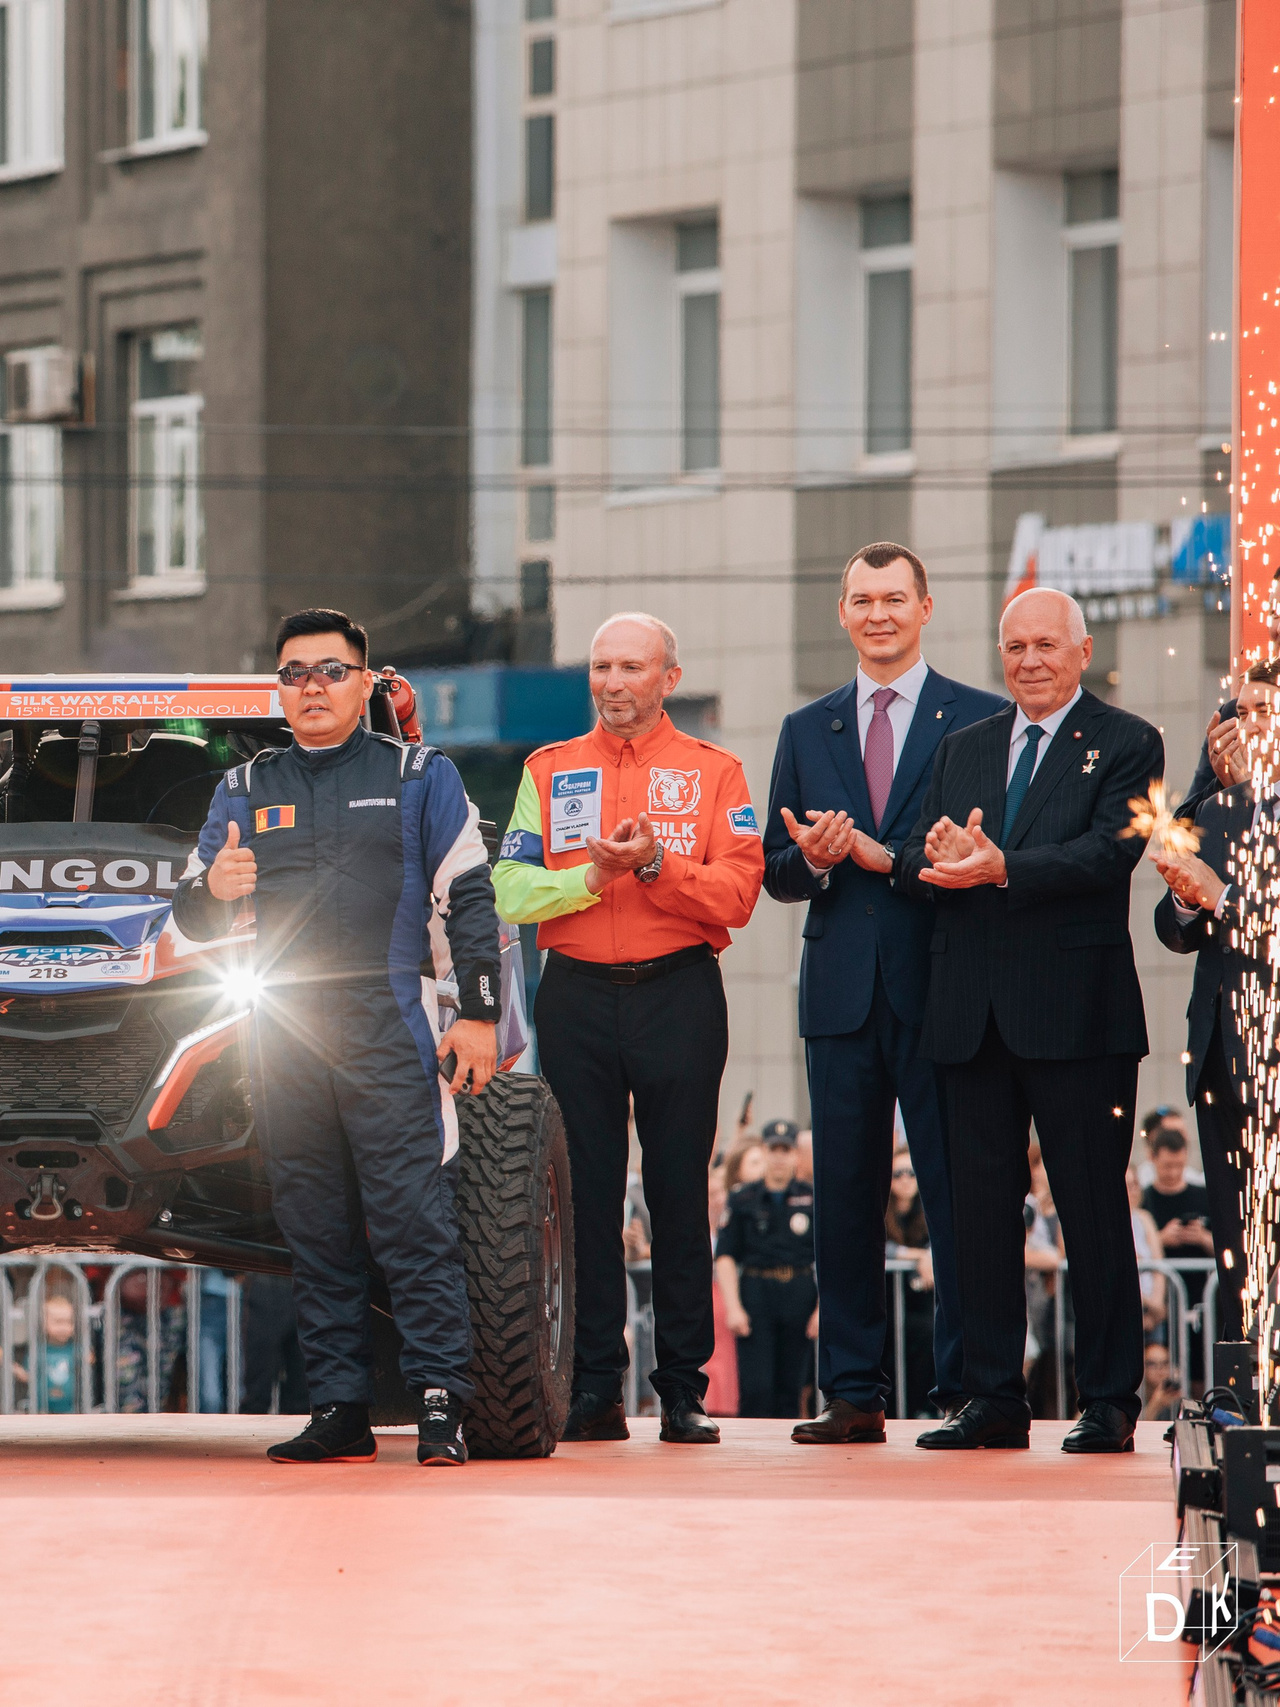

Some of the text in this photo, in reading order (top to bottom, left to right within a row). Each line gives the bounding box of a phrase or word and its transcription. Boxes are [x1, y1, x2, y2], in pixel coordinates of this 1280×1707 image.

[10, 695, 177, 706] SILK WAY RALLY
[16, 706, 44, 717] 15th
[49, 705, 127, 717] EDITION
[154, 704, 262, 716] MONGOLIA
[650, 821, 697, 839] SILK
[59, 950, 132, 962] WAY
[28, 967, 69, 979] 218
